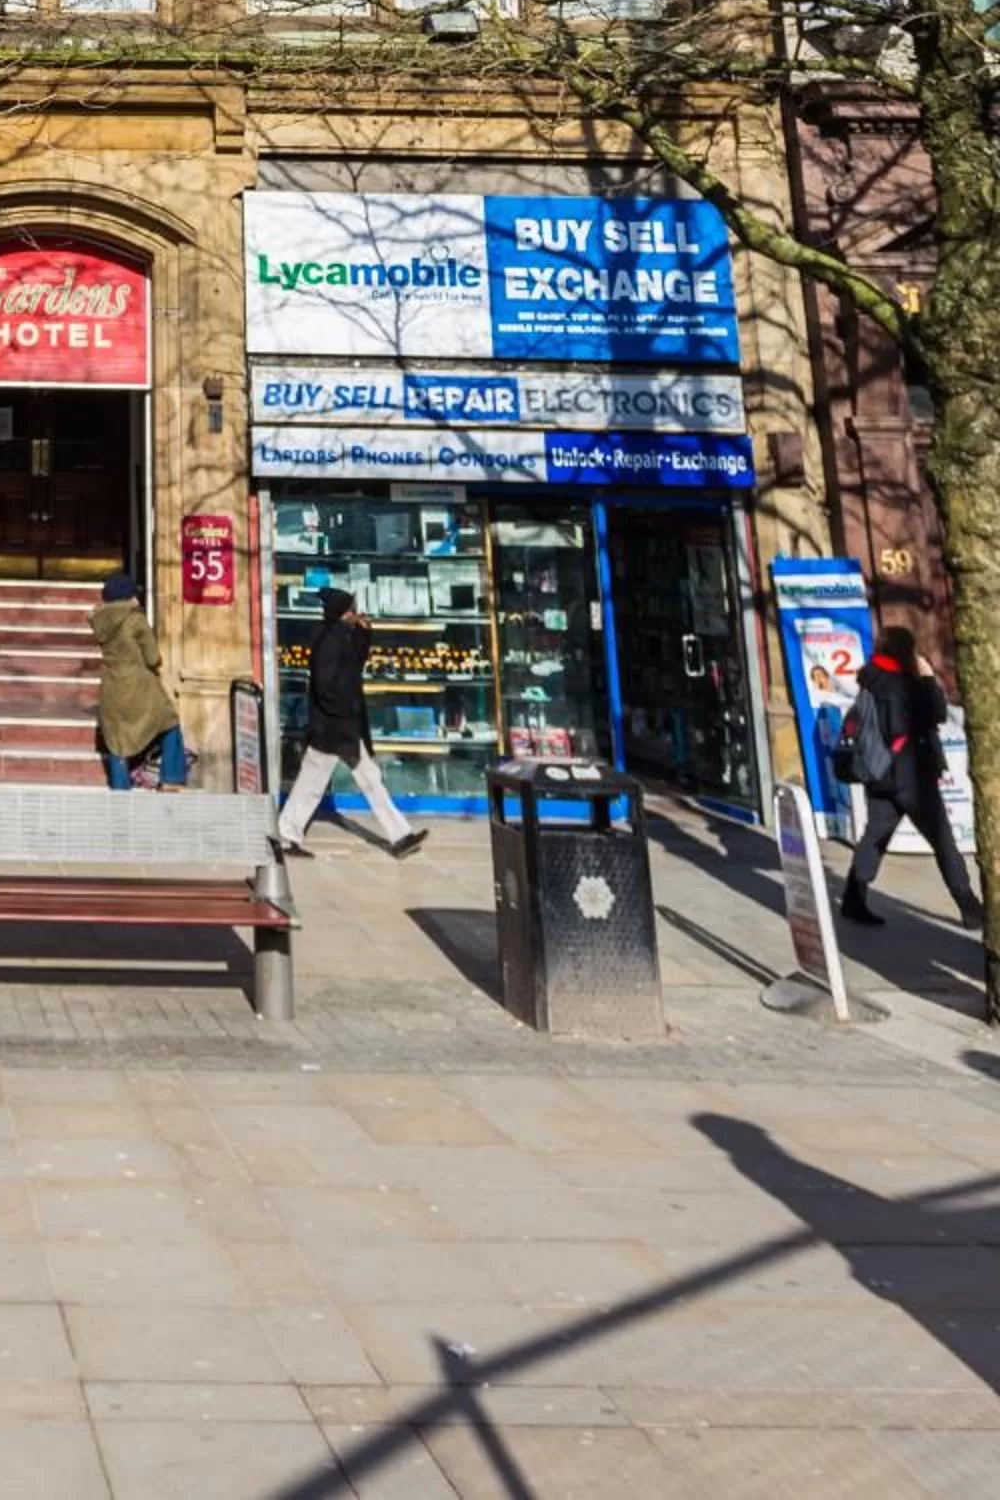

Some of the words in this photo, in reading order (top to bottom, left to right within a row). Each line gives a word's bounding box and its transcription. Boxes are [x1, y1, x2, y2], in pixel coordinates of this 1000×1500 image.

[515, 218, 592, 251] BUY
[604, 220, 699, 254] SELL
[257, 254, 481, 290] Lycamobile
[504, 267, 719, 304] EXCHANGE
[263, 383, 322, 406] BUY
[333, 385, 398, 410] SELL
[407, 386, 514, 412] REPAIR
[525, 388, 733, 417] ELECTRONICS
[552, 448, 605, 469] Unlock
[613, 449, 663, 471] Repair
[672, 451, 747, 476] Exchange
[191, 551, 223, 580] 55
[881, 549, 912, 575] 59
